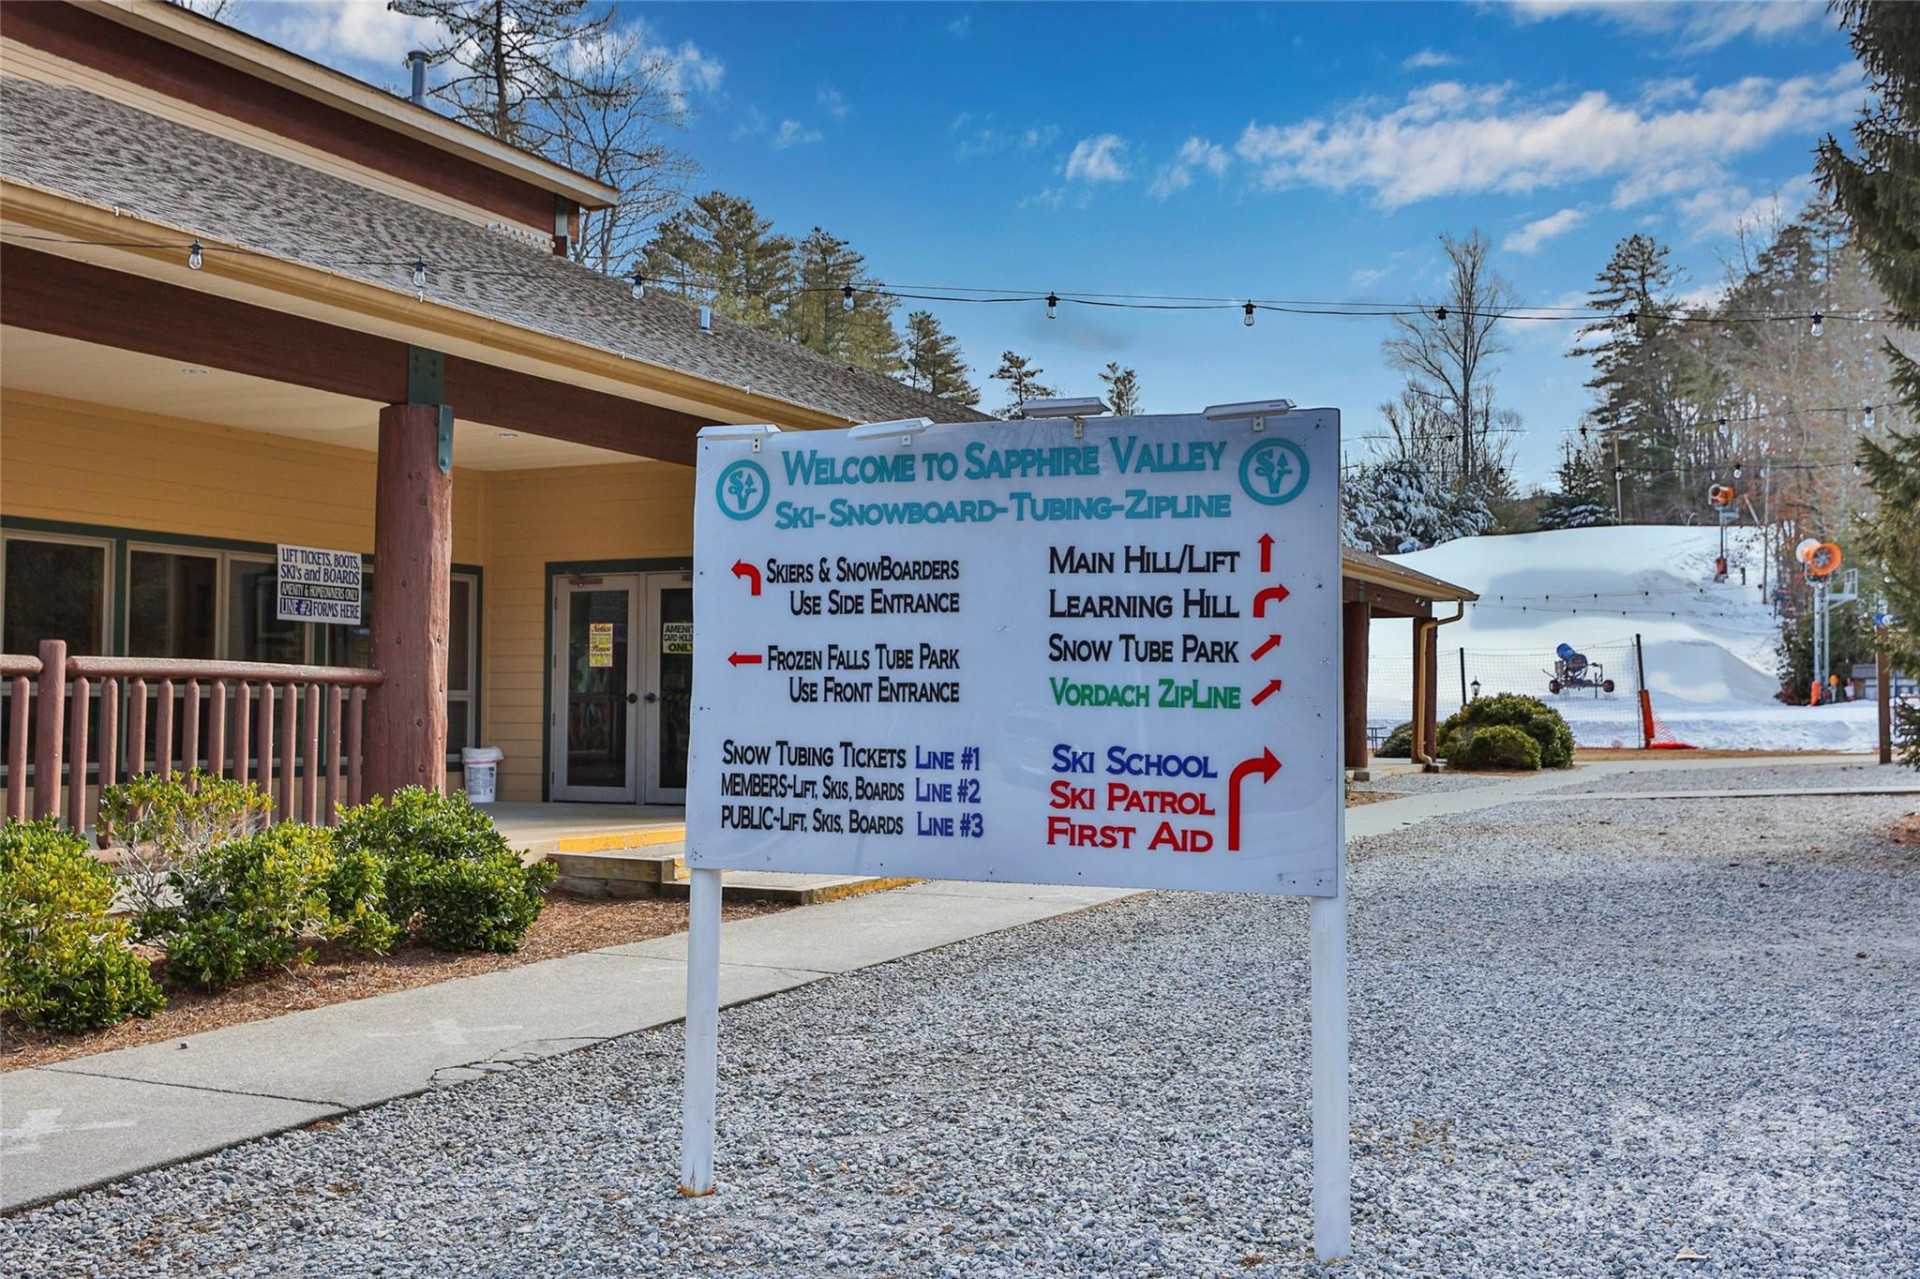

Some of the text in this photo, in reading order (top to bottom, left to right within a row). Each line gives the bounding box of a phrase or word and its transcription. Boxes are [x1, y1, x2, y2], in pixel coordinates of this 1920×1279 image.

[782, 436, 1227, 485] WELCOME TO SAPPHIRE VALLEY
[282, 548, 298, 563] LIFT
[766, 555, 959, 584] SKIERS & SNOWBOARDERS
[1049, 546, 1115, 574] MAIN
[304, 567, 321, 581] and
[323, 569, 359, 585] BOARDS
[281, 598, 298, 614] LINE
[313, 601, 338, 617] FORMS
[340, 604, 360, 619] HERE
[790, 588, 960, 616] USE SIDE ENTRANCE
[1049, 588, 1240, 618] LEARNING HILL
[767, 643, 960, 671] FROZEN FALLS TUBE PARK
[1048, 633, 1239, 663] SNOW TUBE PARK
[789, 676, 960, 703] USE FRONT ENTRANCE
[1049, 677, 1241, 709] VORDACH ZIPLINE
[722, 739, 980, 771] SNOW TUBING TICKETS LINE #1
[1051, 743, 1218, 779] SKI SCHOOL
[855, 776, 904, 801] BOARDS
[916, 777, 952, 803] LINE
[957, 778, 981, 804] #2
[1049, 780, 1215, 816] SKI PATROL
[849, 809, 904, 835] BOARDS
[917, 811, 954, 837] LINE
[960, 812, 984, 838] #3
[1047, 816, 1213, 853] FIRST AID
